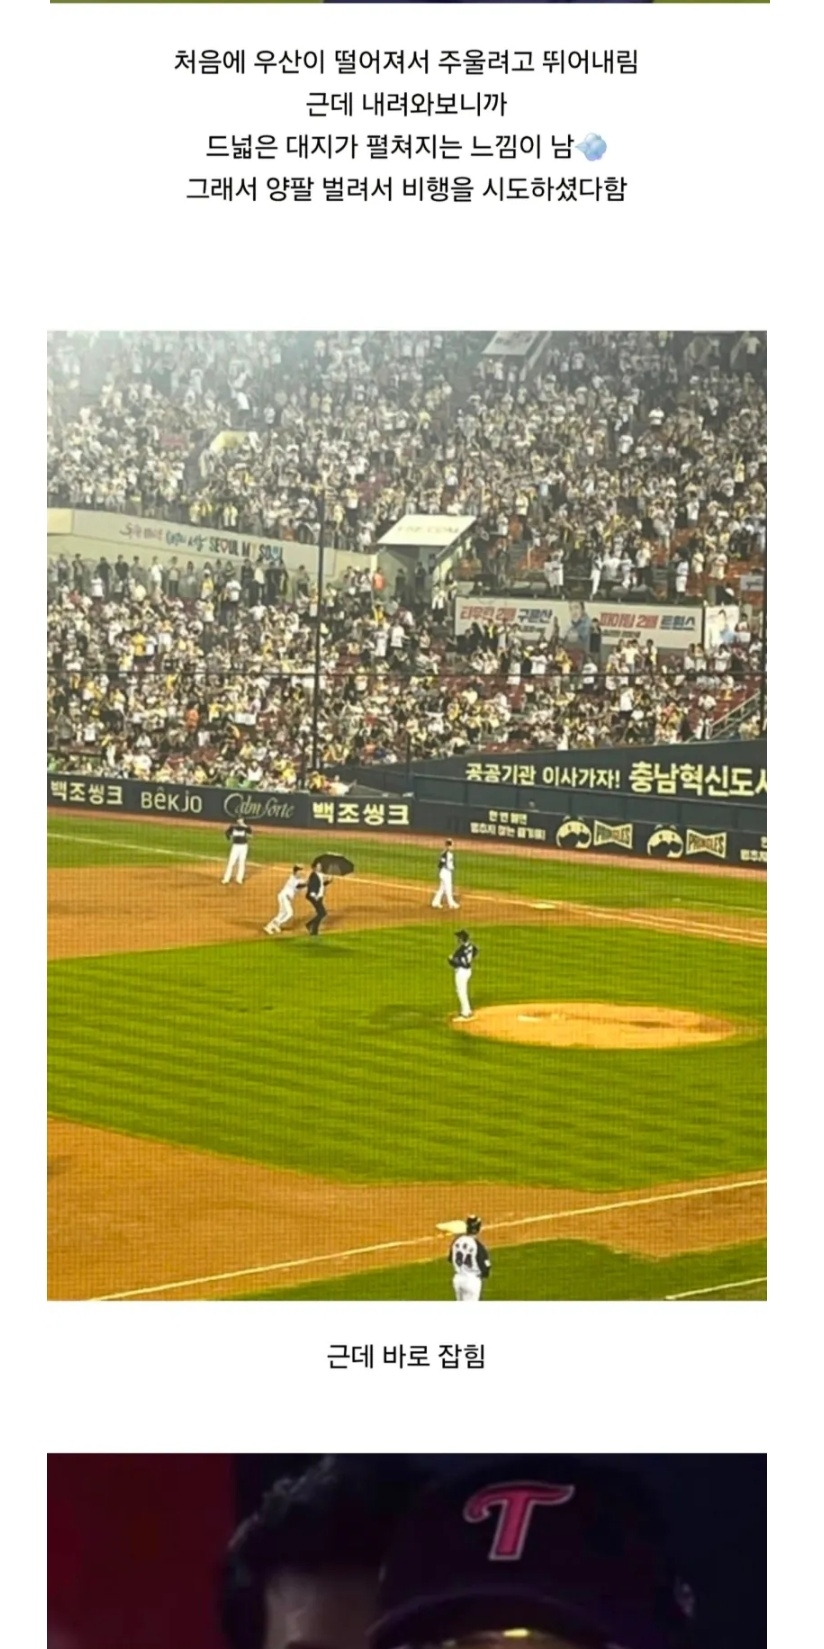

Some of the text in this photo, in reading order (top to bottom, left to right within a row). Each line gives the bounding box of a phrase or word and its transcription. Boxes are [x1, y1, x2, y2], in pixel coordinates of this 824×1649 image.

[465, 762, 536, 786] 공공기관
[542, 766, 621, 789] 이사가자!
[50, 780, 123, 805] 백조씽크
[312, 801, 410, 826] 백조씽크
[462, 1479, 575, 1561] T
